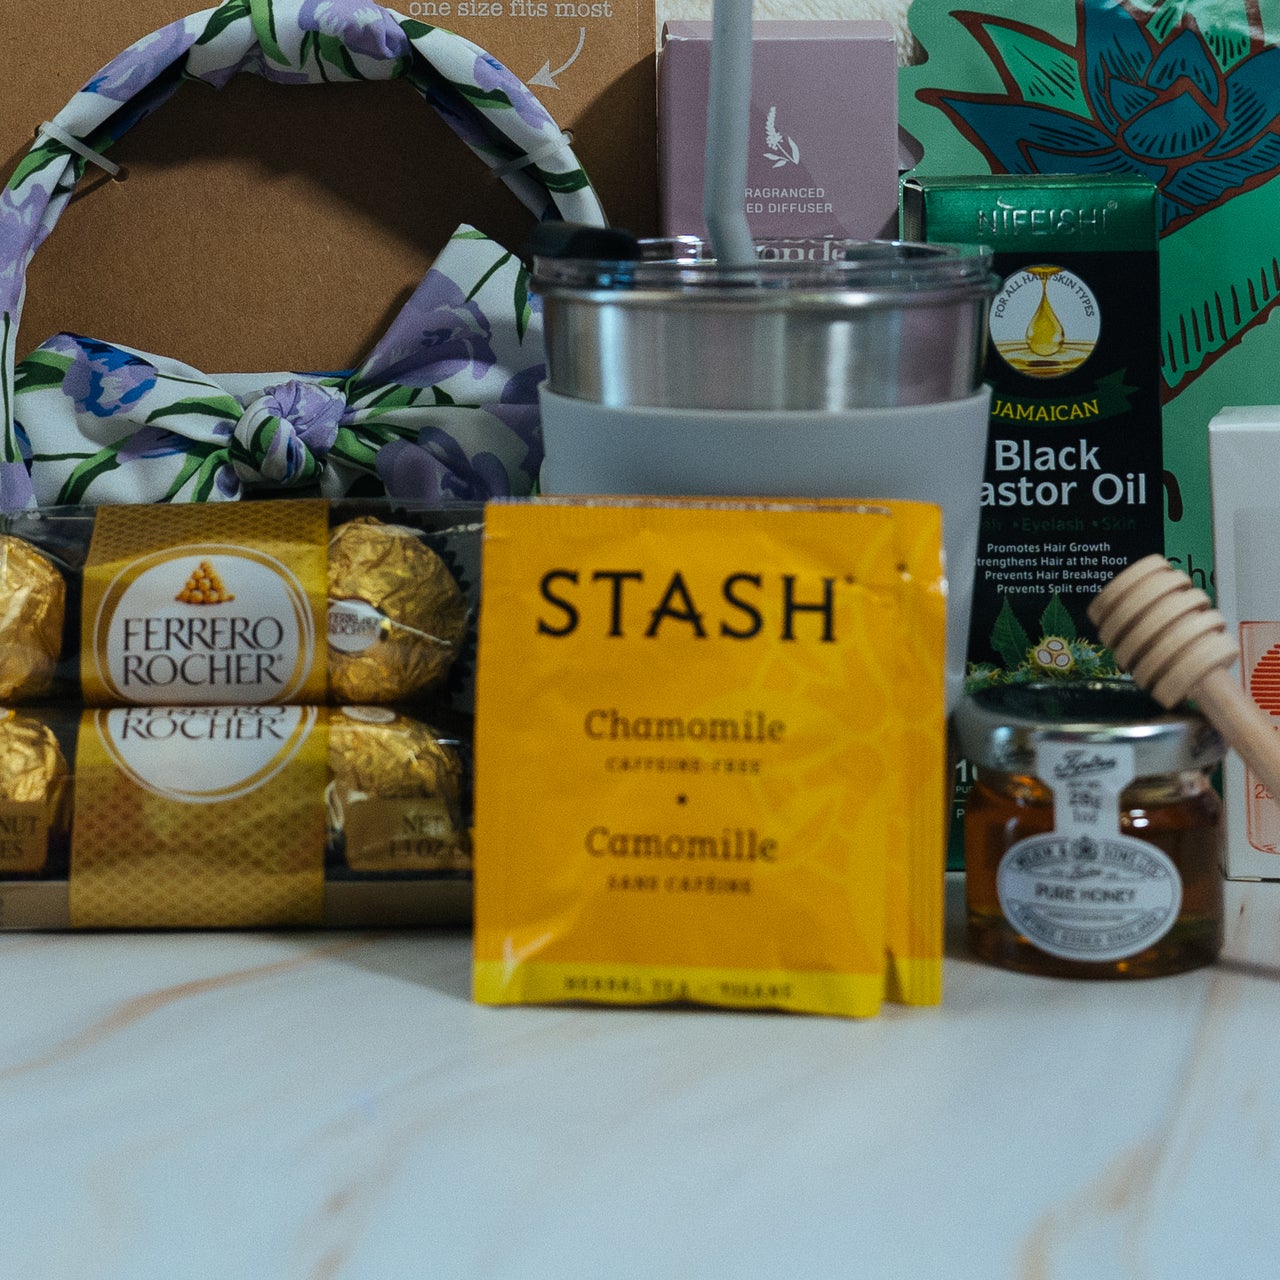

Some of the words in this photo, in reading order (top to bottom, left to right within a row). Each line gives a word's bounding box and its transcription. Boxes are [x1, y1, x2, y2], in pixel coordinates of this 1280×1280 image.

[409, 1, 452, 17] one
[457, 0, 504, 18] size
[509, 0, 549, 18] fits
[554, 0, 614, 18] most
[743, 187, 826, 199] RAGRANCED
[768, 202, 833, 214] DIFFUSER
[994, 296, 1009, 319] FOR
[1006, 279, 1024, 299] ALL
[1074, 285, 1095, 317] TYPES
[991, 399, 1100, 422] JAMAICAN
[994, 439, 1102, 471] Black
[978, 476, 1077, 506] astor
[1092, 472, 1147, 505] Oil
[987, 543, 1040, 554] Promotes
[1044, 542, 1066, 553] Hair
[1069, 542, 1111, 553] Growth
[976, 557, 1038, 570] trengthens
[1041, 557, 1064, 567] Hair
[1066, 557, 1078, 566] at
[1080, 556, 1098, 566] the
[1102, 555, 1128, 566] Root
[985, 571, 1033, 581] Prevents
[1037, 570, 1059, 580] Hair
[1062, 570, 1114, 582] Breakage
[996, 584, 1045, 595] Prevents
[1048, 584, 1073, 595] Split
[1076, 584, 1103, 594] ends
[535, 568, 839, 644] STASH
[122, 616, 285, 652] FERRERO
[122, 653, 284, 687] ROCHER
[583, 708, 788, 744] Chamomile
[583, 824, 780, 863] Camomille
